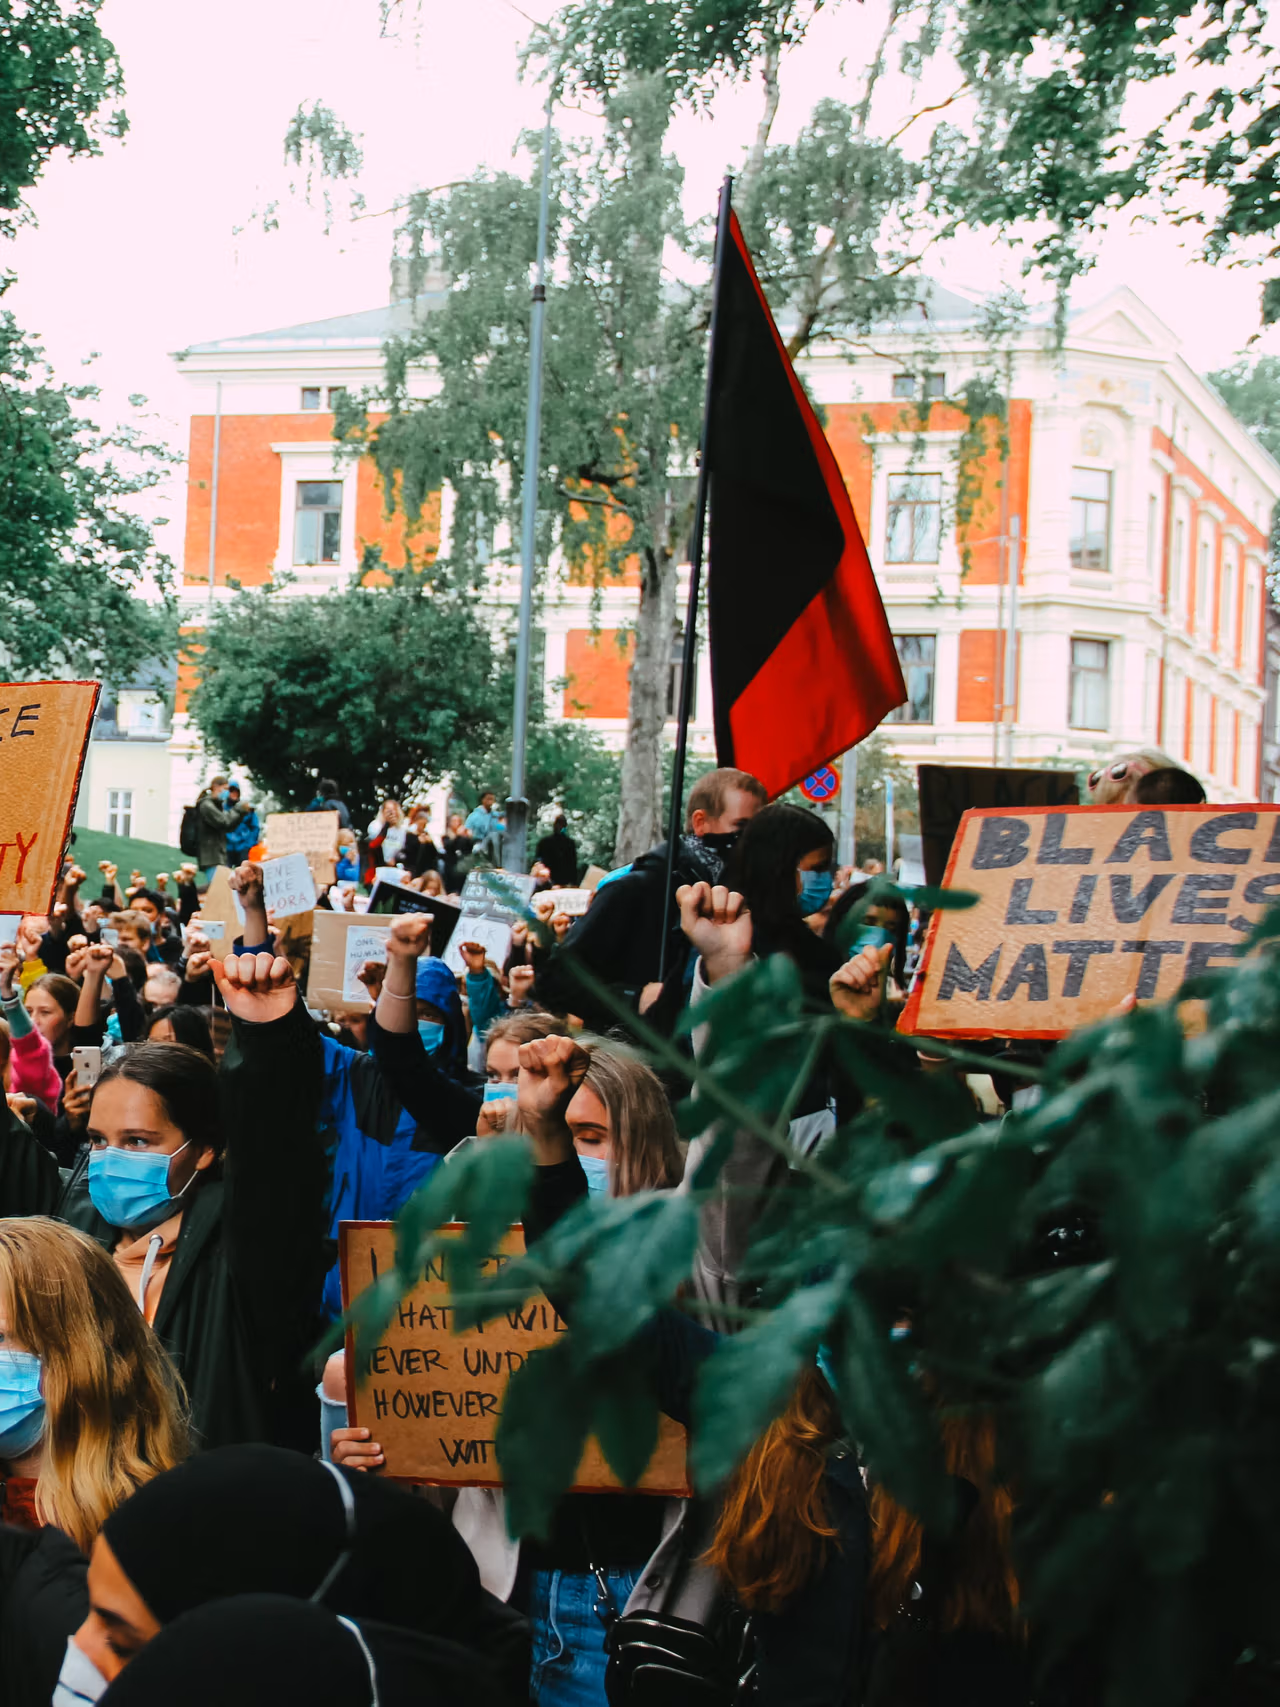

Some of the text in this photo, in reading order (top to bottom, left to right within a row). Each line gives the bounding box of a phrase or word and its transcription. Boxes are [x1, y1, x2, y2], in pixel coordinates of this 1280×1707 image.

[972, 809, 1280, 870] BLAC
[384, 1301, 456, 1331] HAT
[369, 1345, 449, 1377] EVER
[373, 1388, 503, 1420] HOWEVER
